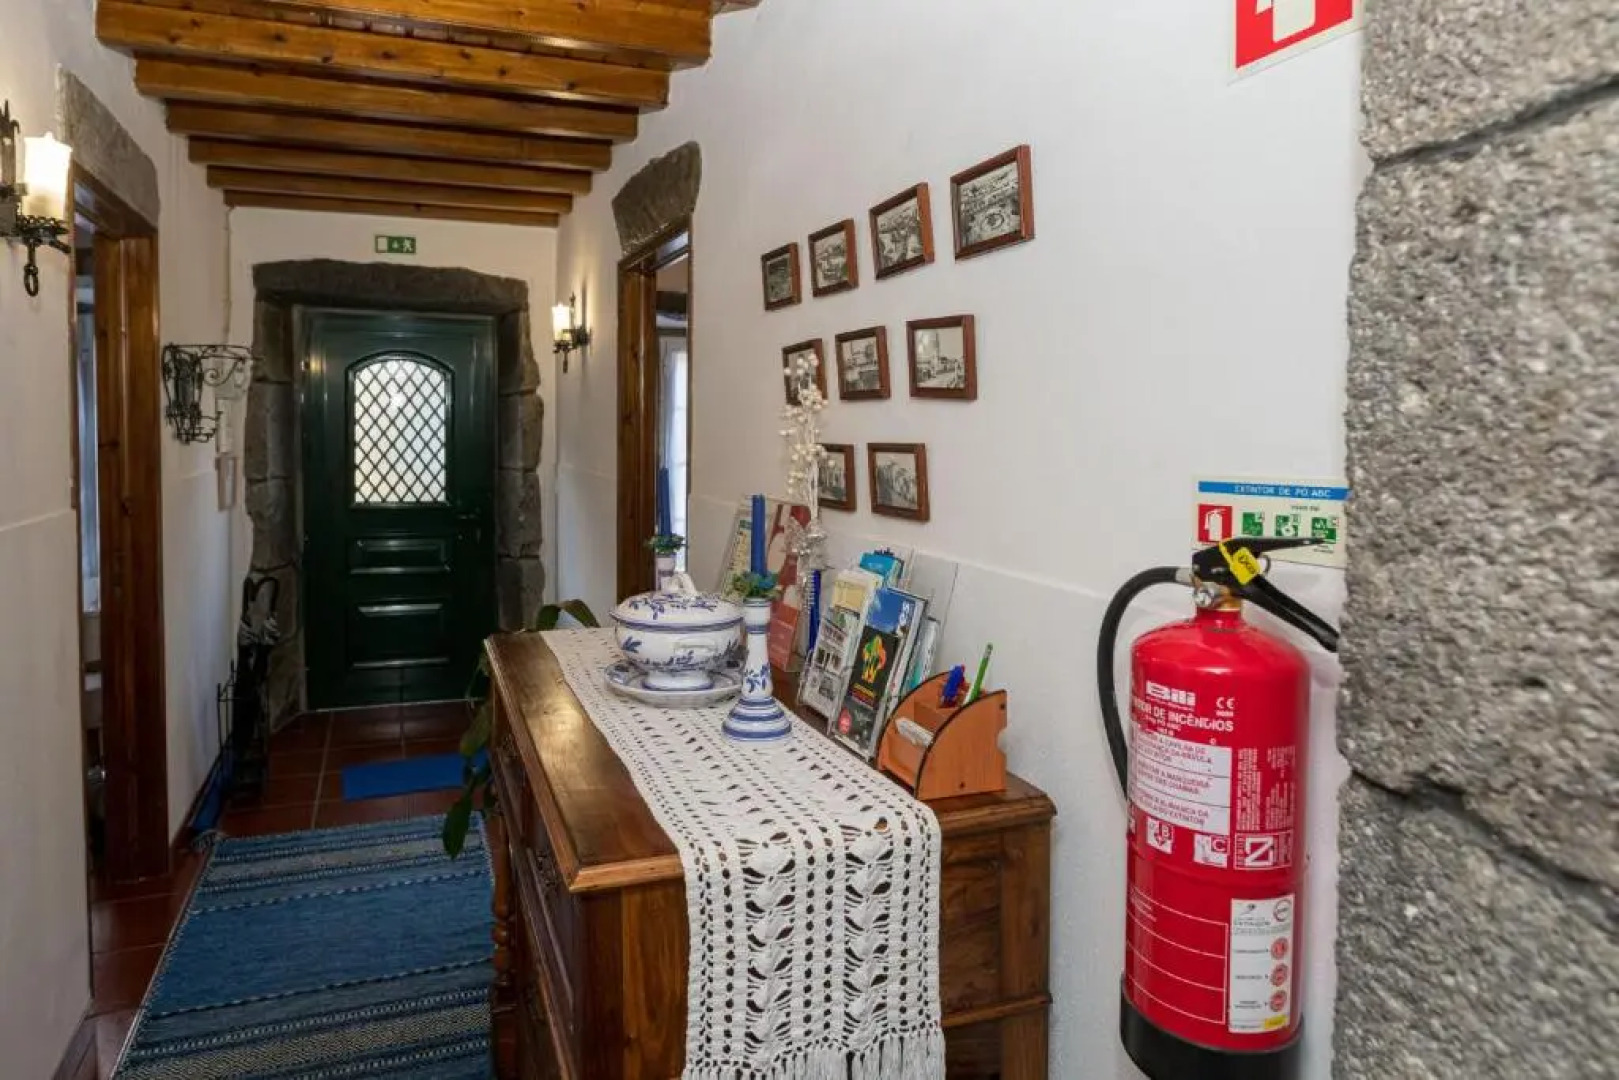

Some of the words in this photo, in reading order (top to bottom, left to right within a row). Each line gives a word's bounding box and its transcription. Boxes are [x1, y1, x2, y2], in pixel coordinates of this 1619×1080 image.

[1234, 485, 1275, 495] EXTINTOR
[1279, 486, 1291, 496] DE
[1311, 488, 1331, 498] ABC
[1153, 706, 1166, 718] DE
